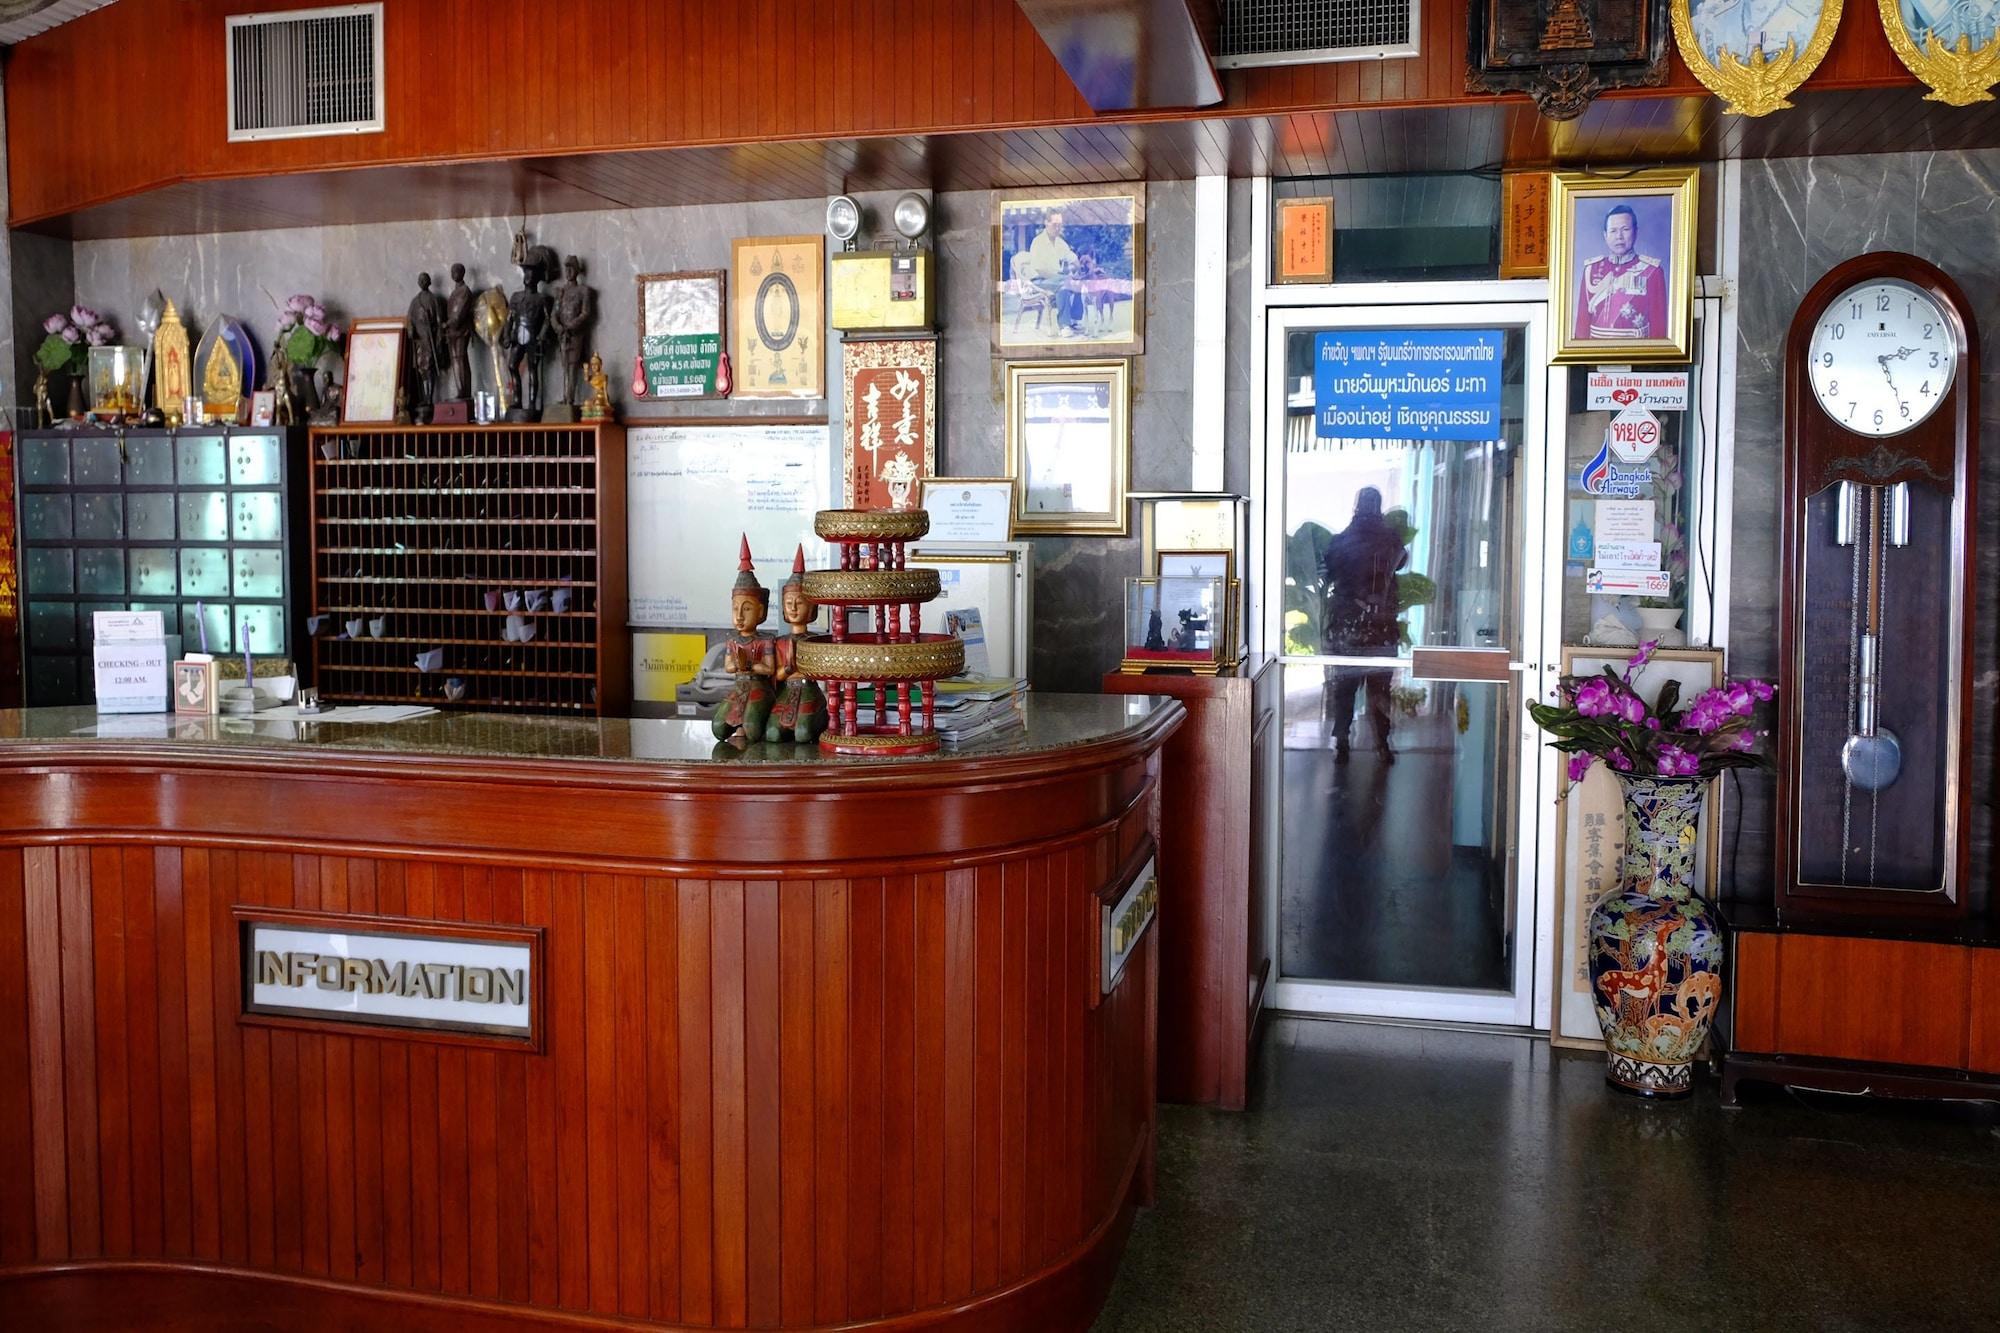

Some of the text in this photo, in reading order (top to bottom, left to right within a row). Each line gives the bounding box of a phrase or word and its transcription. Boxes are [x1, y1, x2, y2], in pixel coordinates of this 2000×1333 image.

[1851, 303, 1863, 320] 11
[1876, 295, 1890, 311] 12
[1906, 302, 1912, 319] 1
[1831, 323, 1845, 340] 10
[1923, 323, 1933, 340] 2
[1322, 341, 1349, 366] คำขวัญ
[1823, 352, 1834, 368] 9
[1928, 352, 1939, 368] 3
[1334, 369, 1487, 399] นายวันมูหะมัดนอร์ มะทา
[1829, 380, 1839, 397] 8
[1919, 380, 1930, 397] 4
[1595, 391, 1683, 404] เรา รัก บ้านฉาง
[1323, 404, 1490, 432] เมืองน่าอยู่ เชิดชูคุณธรรม
[1848, 402, 1858, 418] 7
[1873, 410, 1883, 426] 6
[1900, 401, 1910, 418] 5
[1610, 466, 1652, 484] Bangkok
[1600, 478, 1640, 497] Airways
[1646, 580, 1669, 591] 1669
[98, 660, 140, 669] CHECKING
[146, 659, 162, 667] OUT
[254, 949, 524, 1006] INFORMATION
